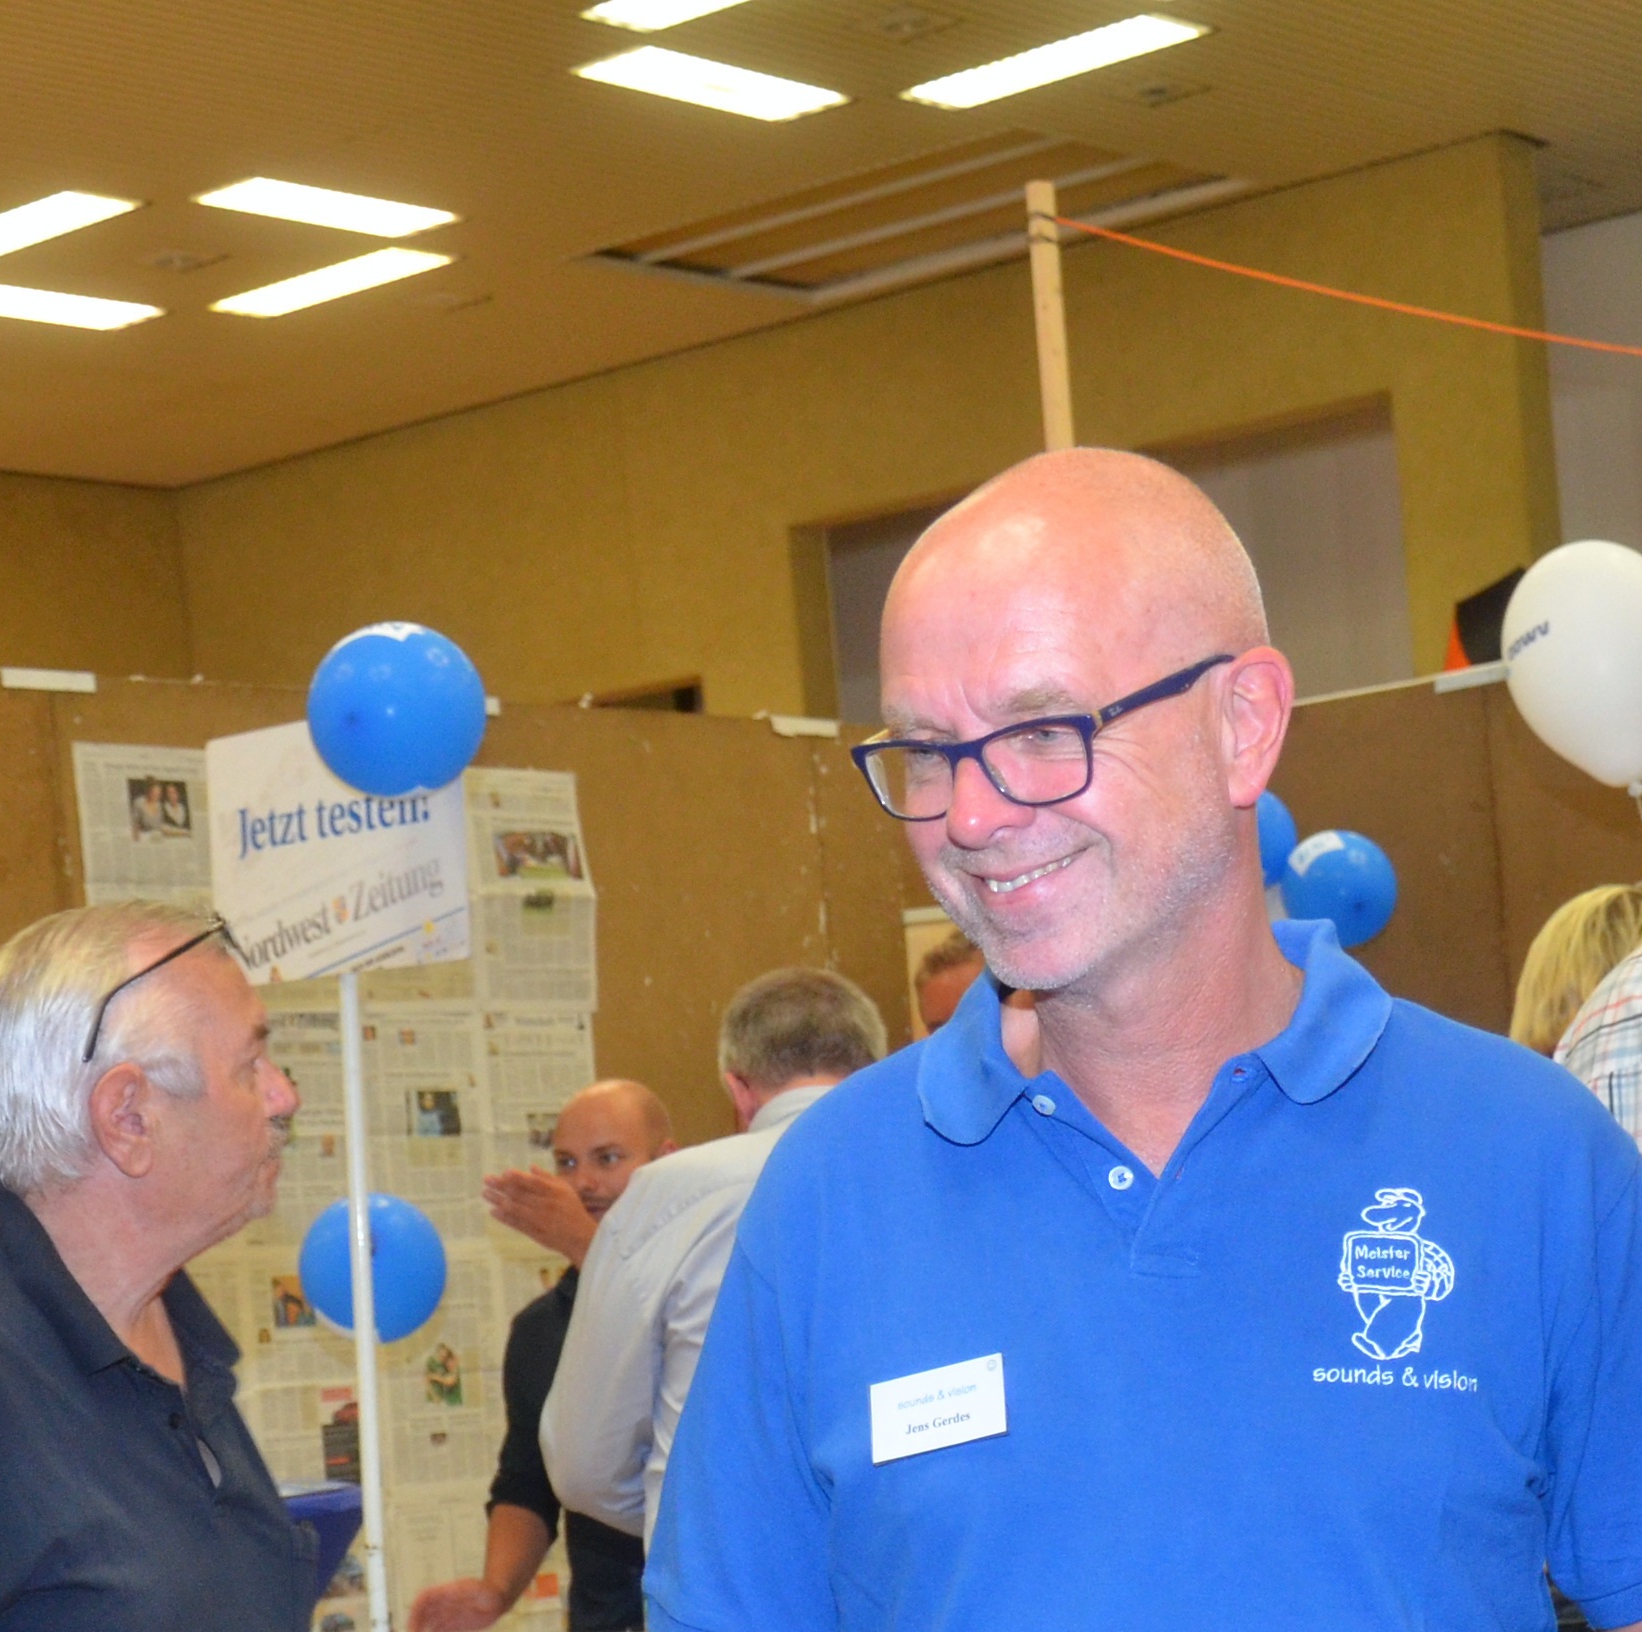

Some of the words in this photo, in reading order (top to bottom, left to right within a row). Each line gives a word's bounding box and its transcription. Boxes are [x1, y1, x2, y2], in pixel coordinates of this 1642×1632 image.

[237, 803, 308, 861] Jetzt
[349, 858, 444, 922] Zeitung
[1355, 1244, 1410, 1261] Meister
[1356, 1265, 1410, 1280] Service
[1312, 1364, 1394, 1386] sounds
[1402, 1366, 1419, 1388] &
[1423, 1370, 1478, 1393] vision
[905, 1420, 929, 1436] Jens
[932, 1412, 971, 1429] Gerdes
